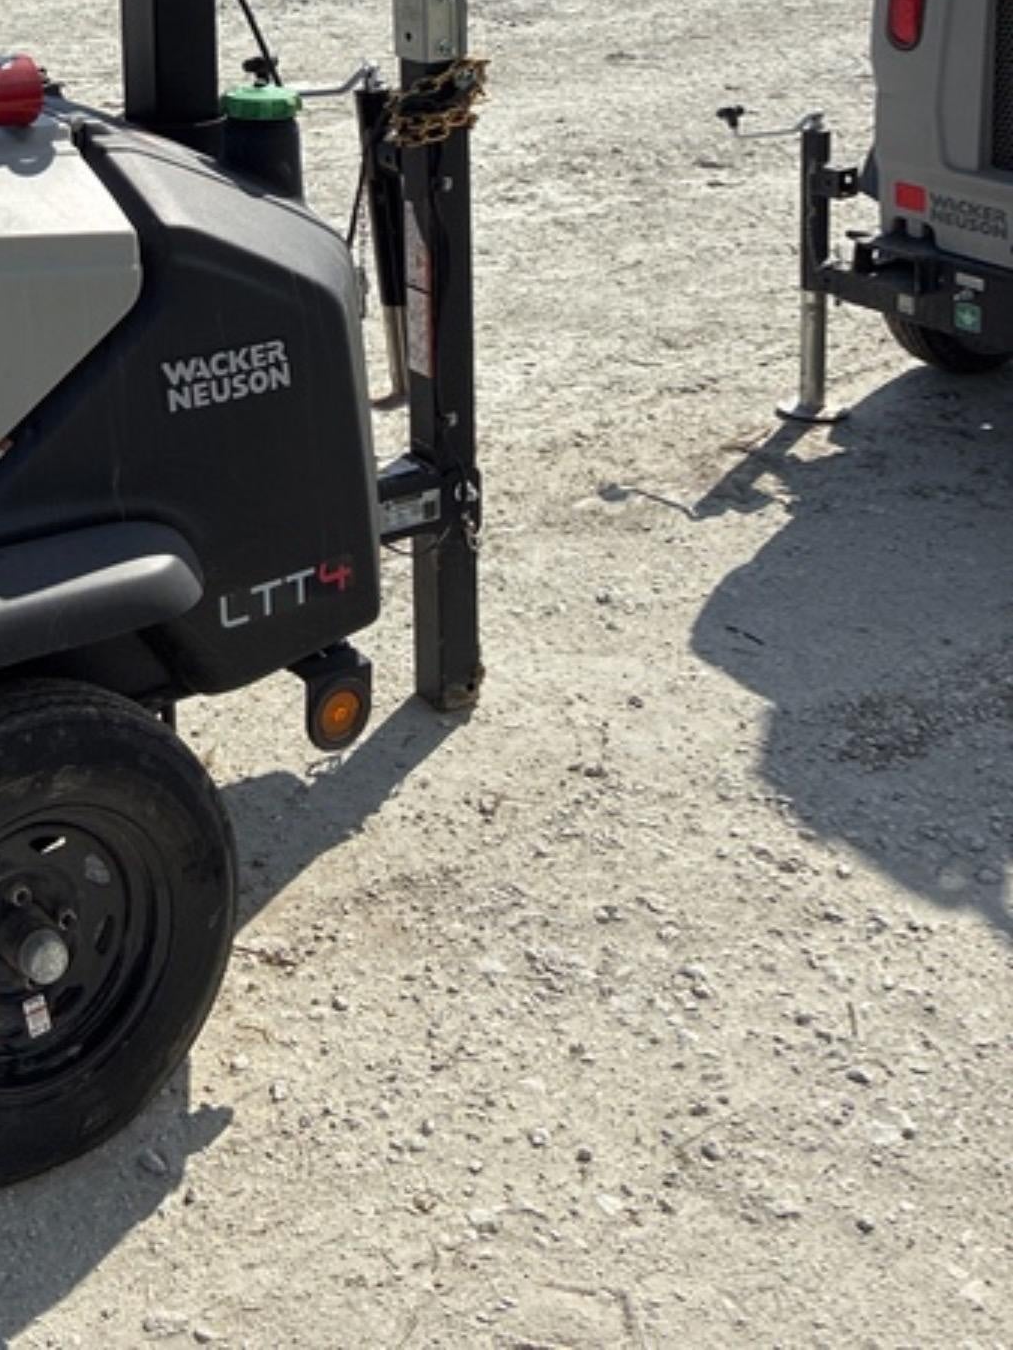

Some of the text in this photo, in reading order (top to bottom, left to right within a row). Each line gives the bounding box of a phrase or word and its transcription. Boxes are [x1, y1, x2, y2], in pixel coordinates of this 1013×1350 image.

[162, 340, 288, 385] WACKER
[167, 363, 291, 412] NEUSON
[219, 562, 352, 628] LTT4
